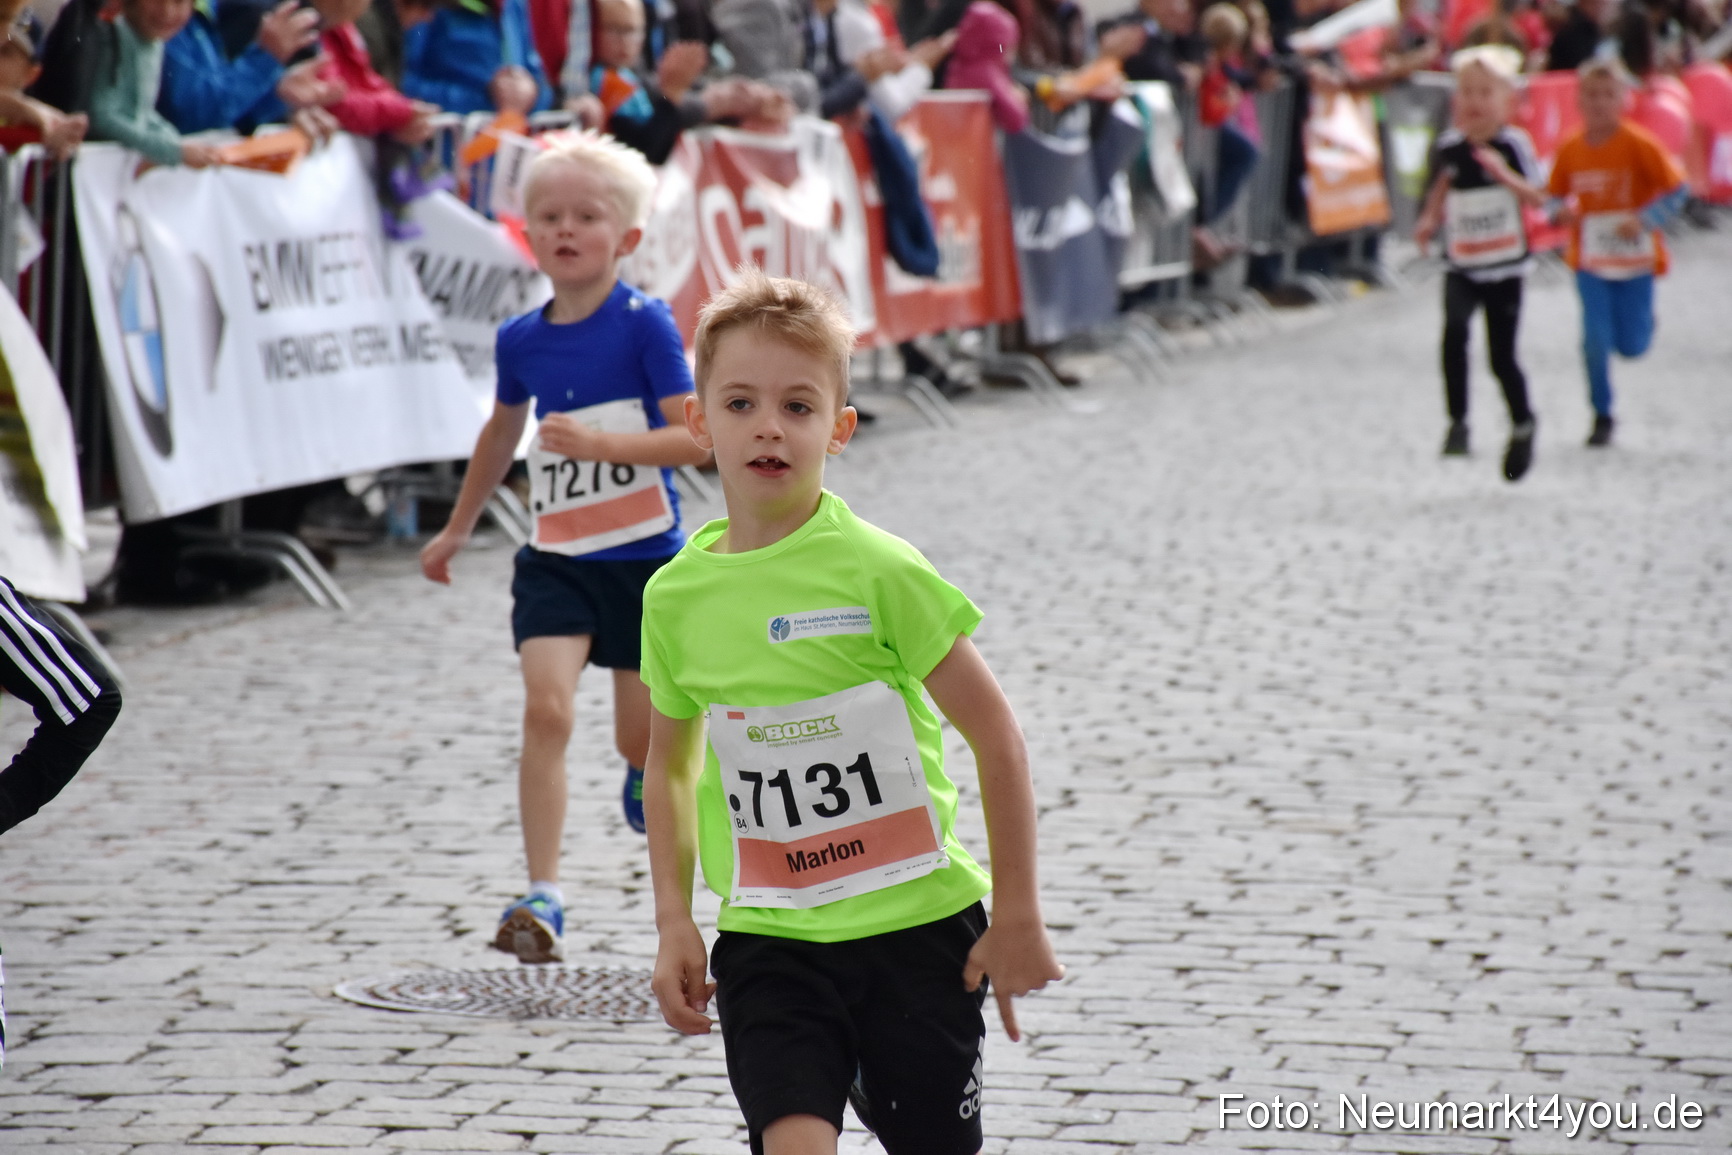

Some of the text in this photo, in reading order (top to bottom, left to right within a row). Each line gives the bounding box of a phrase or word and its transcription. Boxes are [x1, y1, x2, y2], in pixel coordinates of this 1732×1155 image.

[808, 615, 839, 624] katholische
[763, 714, 841, 742] BOCK
[738, 752, 883, 828] 7131
[735, 818, 747, 830] B4
[785, 839, 866, 873] Marlon
